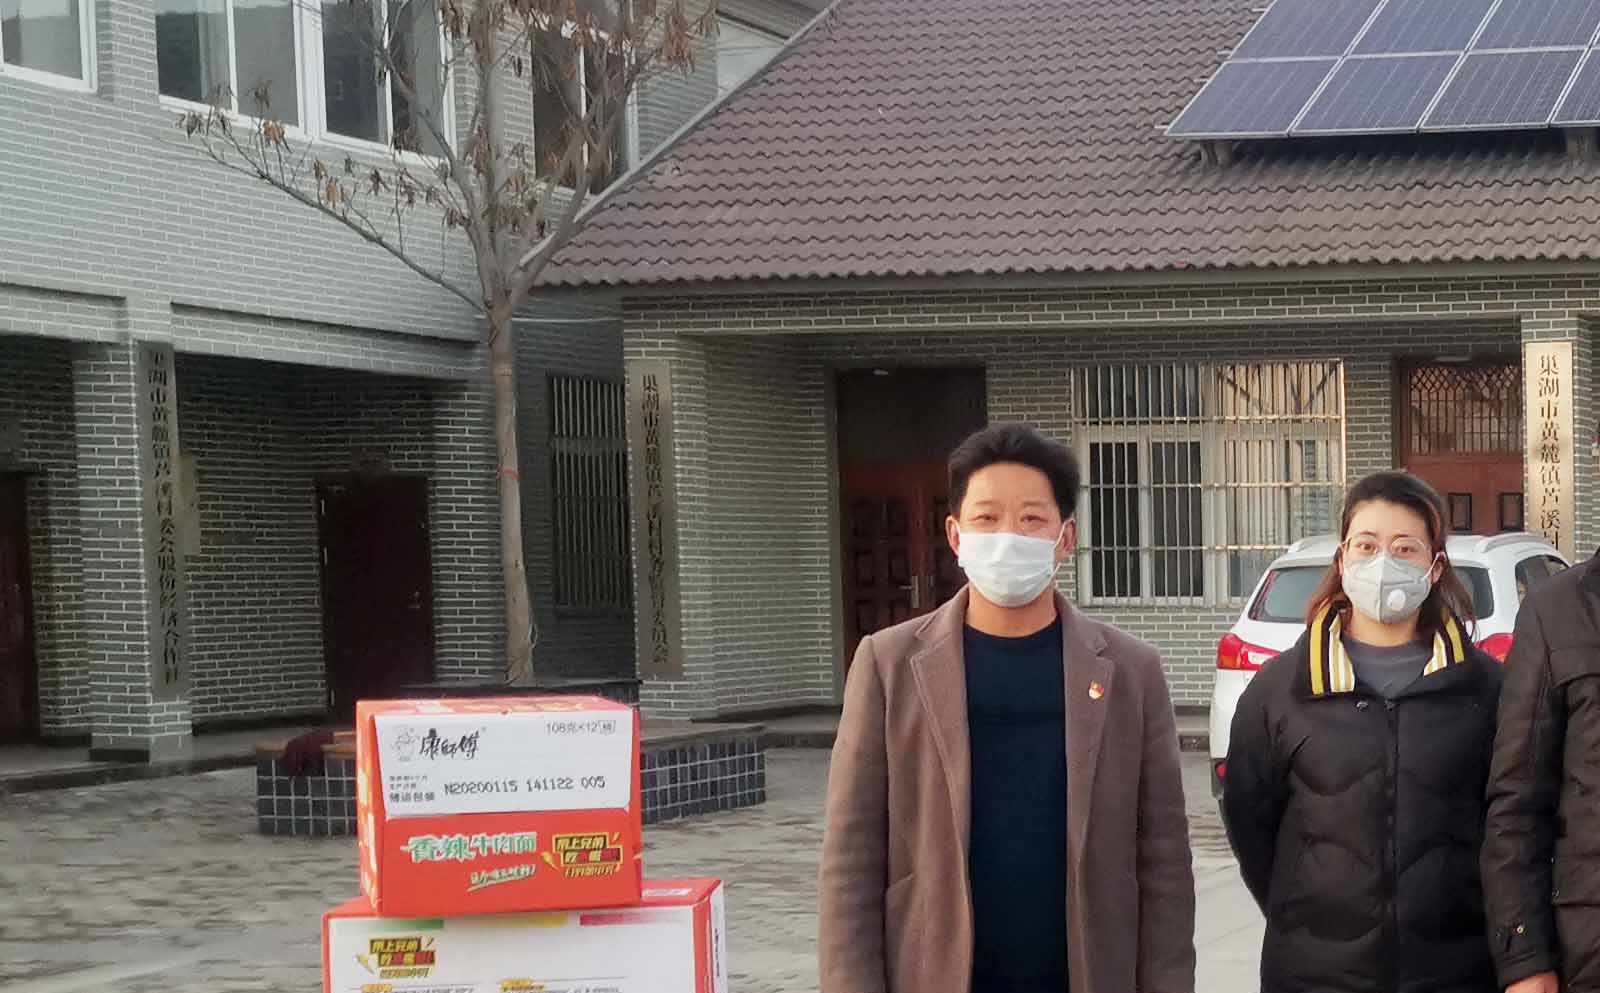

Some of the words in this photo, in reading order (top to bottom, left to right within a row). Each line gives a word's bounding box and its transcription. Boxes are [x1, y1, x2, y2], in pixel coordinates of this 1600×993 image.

[526, 777, 574, 792] 141122
[581, 775, 606, 789] 005
[407, 832, 538, 862] 香辣牛肉面
